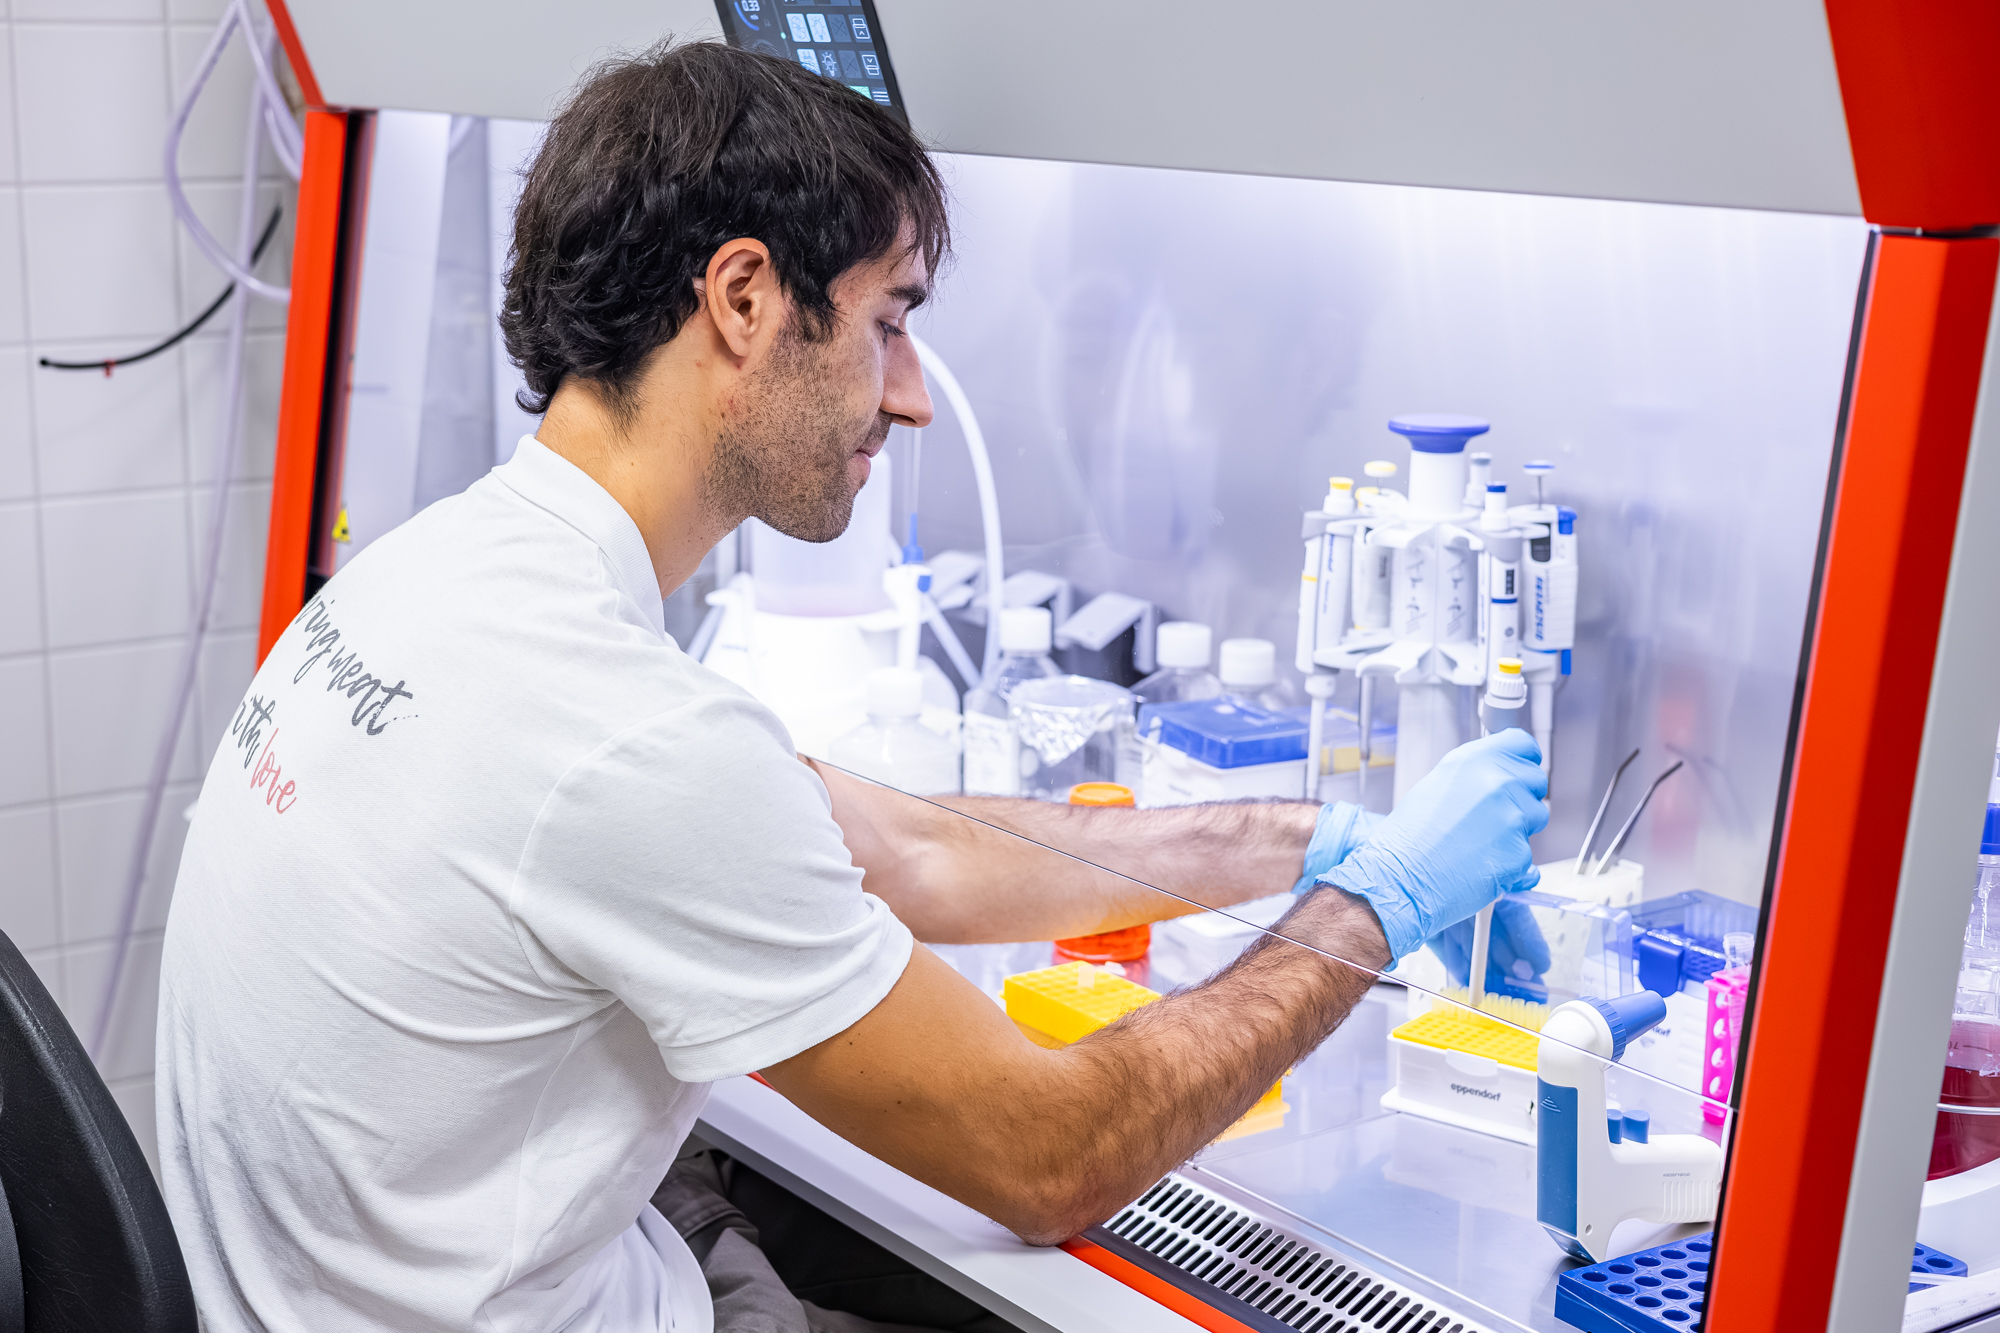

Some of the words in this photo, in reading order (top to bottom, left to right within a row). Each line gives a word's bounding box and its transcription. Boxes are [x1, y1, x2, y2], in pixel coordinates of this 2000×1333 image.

[232, 693, 276, 769] ith
[327, 645, 416, 736] meat
[250, 727, 297, 814] love
[1450, 1083, 1501, 1101] eppendorf
